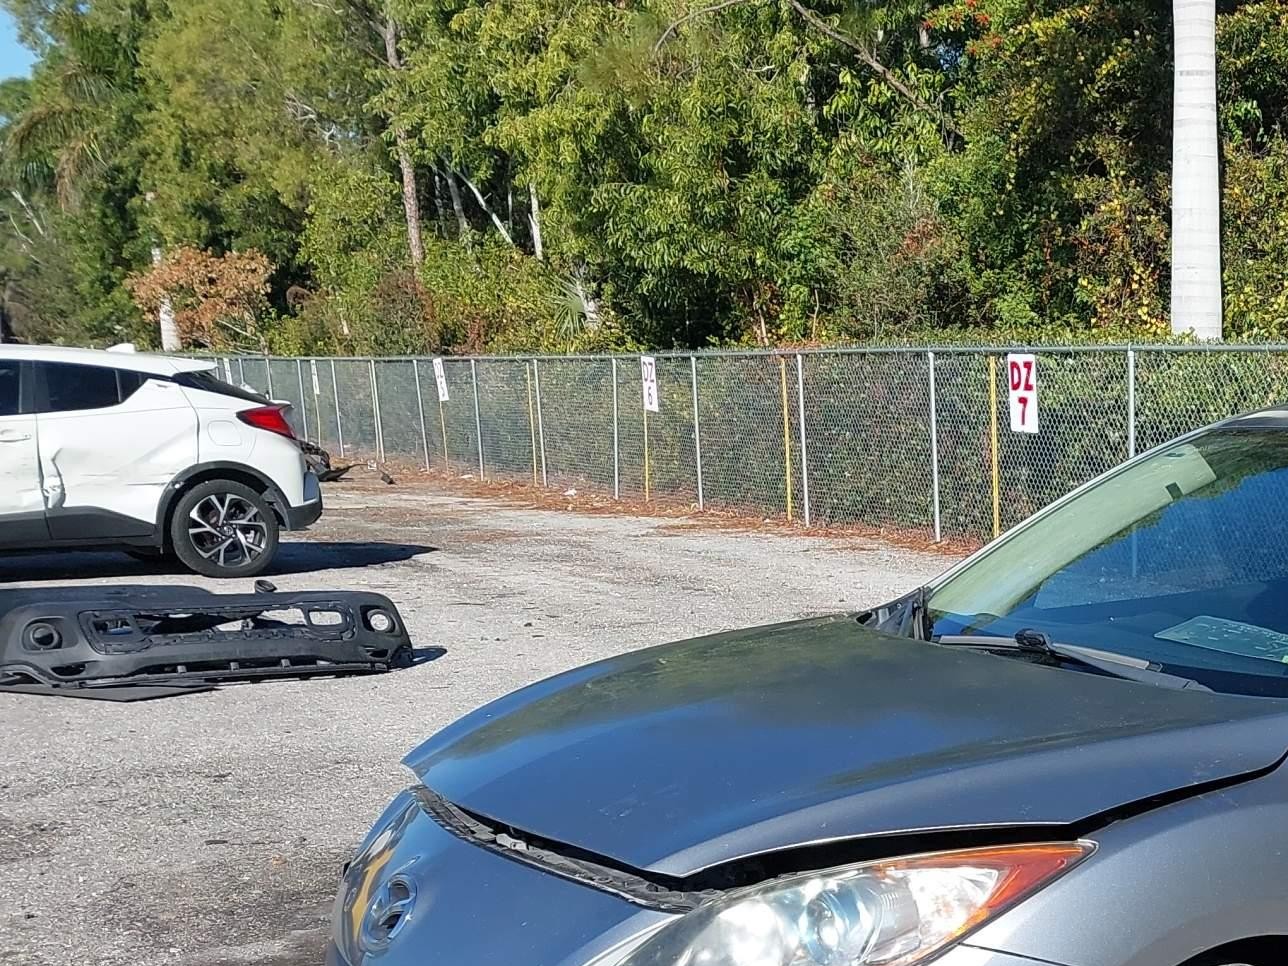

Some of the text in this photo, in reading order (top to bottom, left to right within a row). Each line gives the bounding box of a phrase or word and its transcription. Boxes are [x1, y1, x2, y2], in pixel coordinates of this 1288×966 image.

[643, 361, 655, 383] DZ
[1010, 361, 1034, 391] DZ
[647, 386, 653, 405] 6
[1018, 396, 1028, 426] 7
